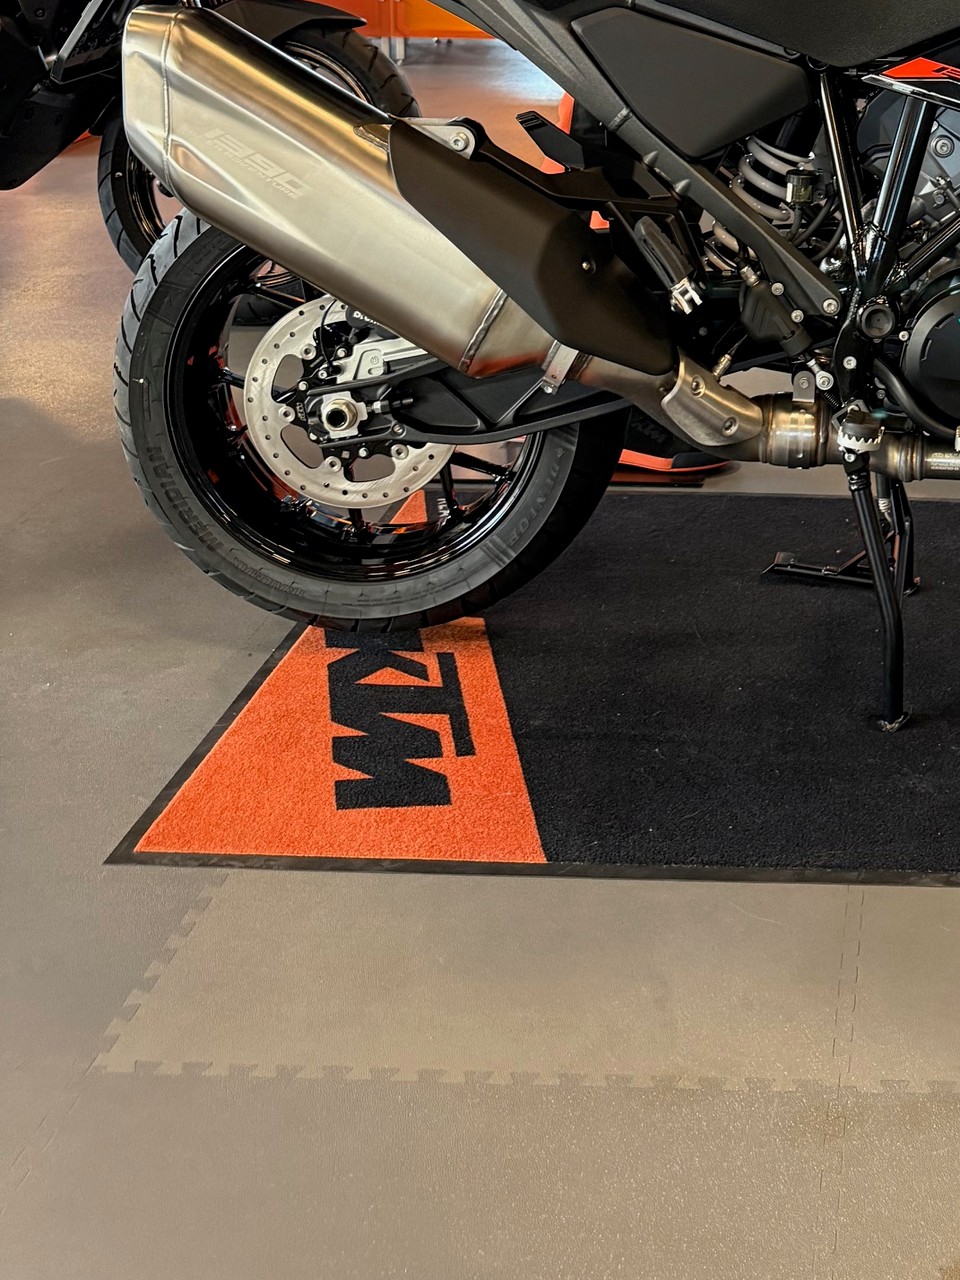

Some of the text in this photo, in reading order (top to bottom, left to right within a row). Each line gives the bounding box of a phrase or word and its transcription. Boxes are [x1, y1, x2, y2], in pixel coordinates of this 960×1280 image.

[203, 127, 314, 196] 1390
[146, 446, 225, 553] MERIDIAN
[325, 626, 477, 811] KTM
